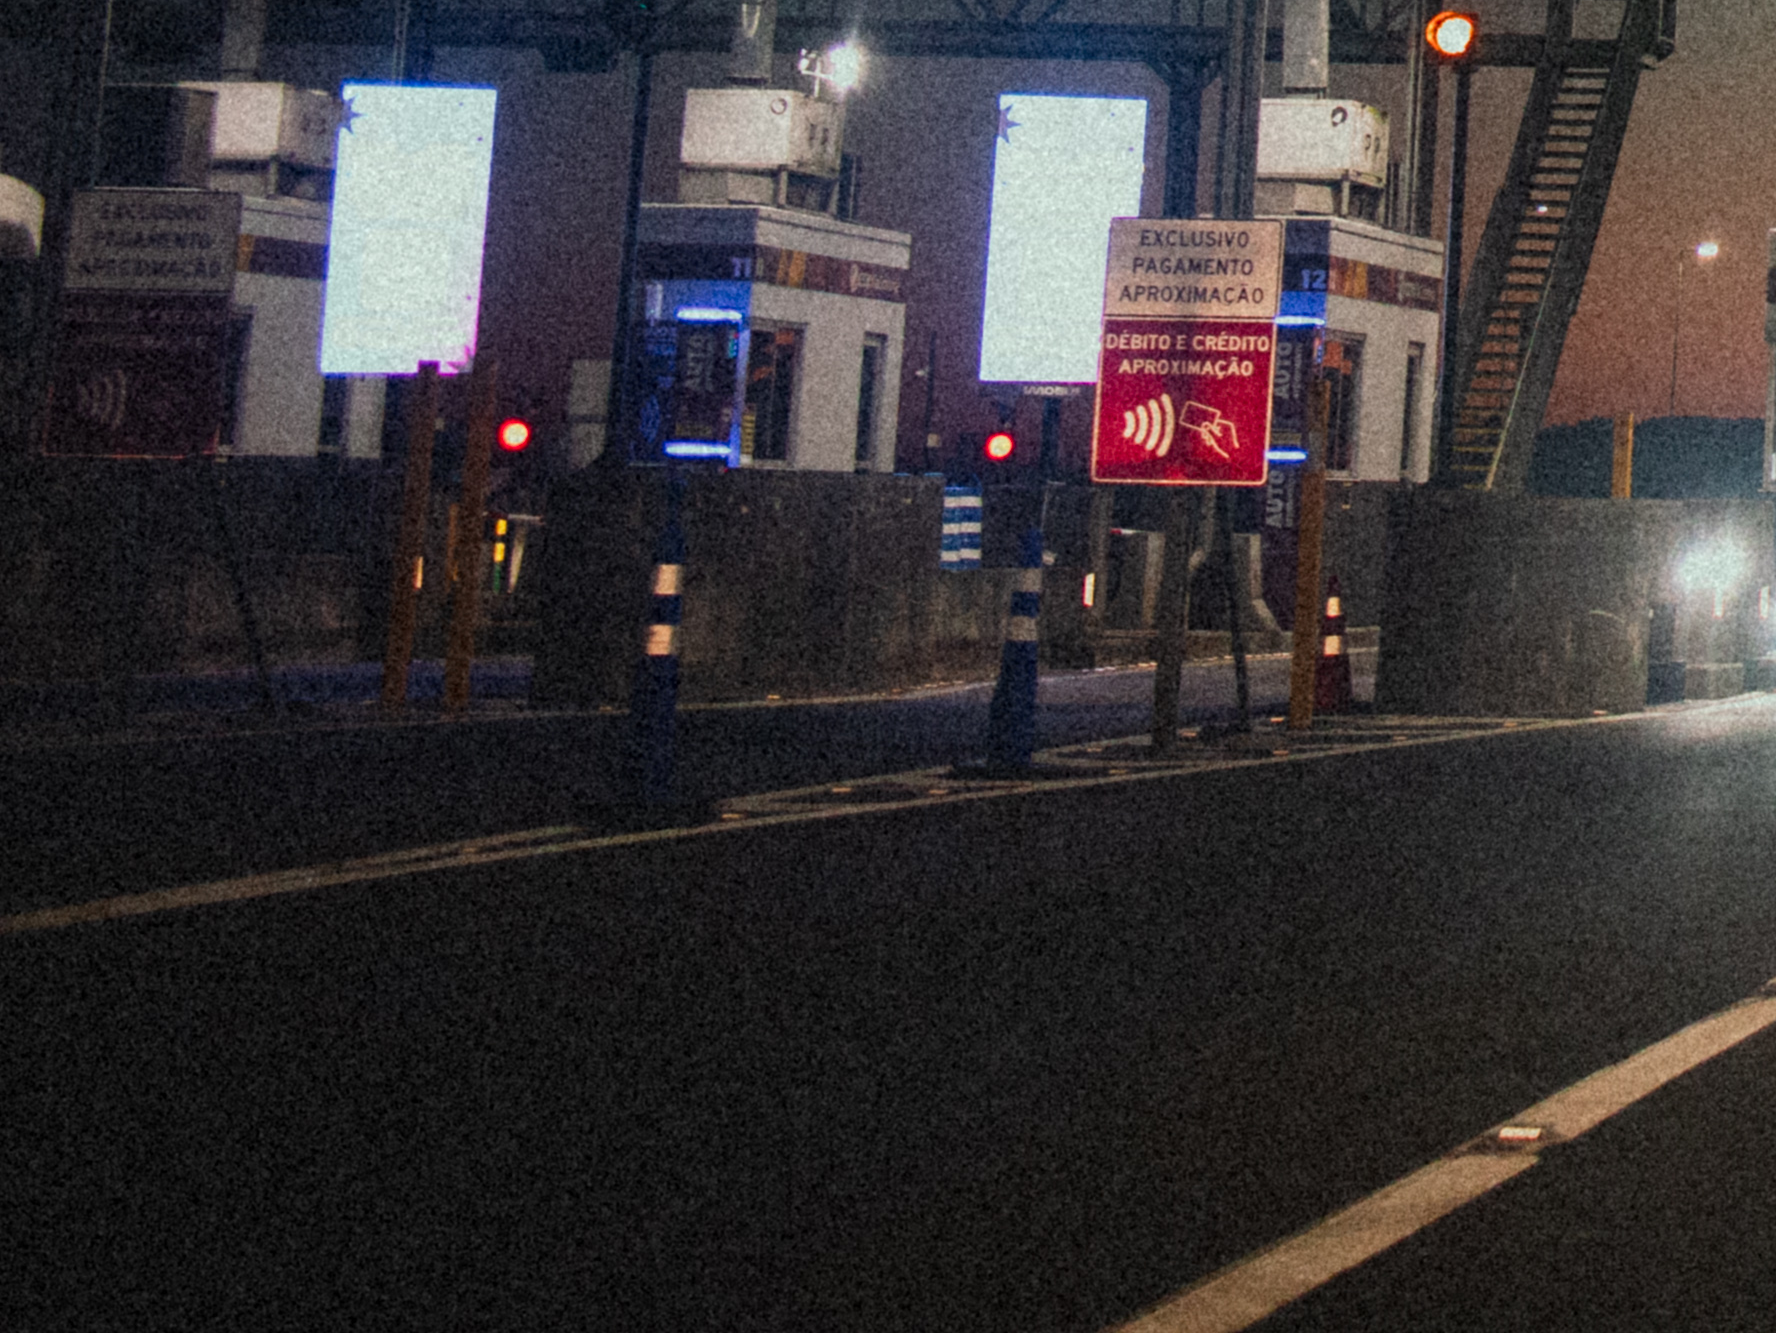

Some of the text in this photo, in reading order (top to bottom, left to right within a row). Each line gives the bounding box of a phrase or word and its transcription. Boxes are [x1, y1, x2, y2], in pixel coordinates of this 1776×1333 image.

[1140, 229, 1250, 249] EXCLUSIVO
[1132, 257, 1254, 276] PAGAMENTO
[1302, 269, 1326, 289] 12
[1119, 282, 1264, 305] APROXIMAÇÃO
[1106, 329, 1270, 352] DÉBITO E CRÉDITO
[1118, 356, 1254, 379] APROXIMAÇÃO
